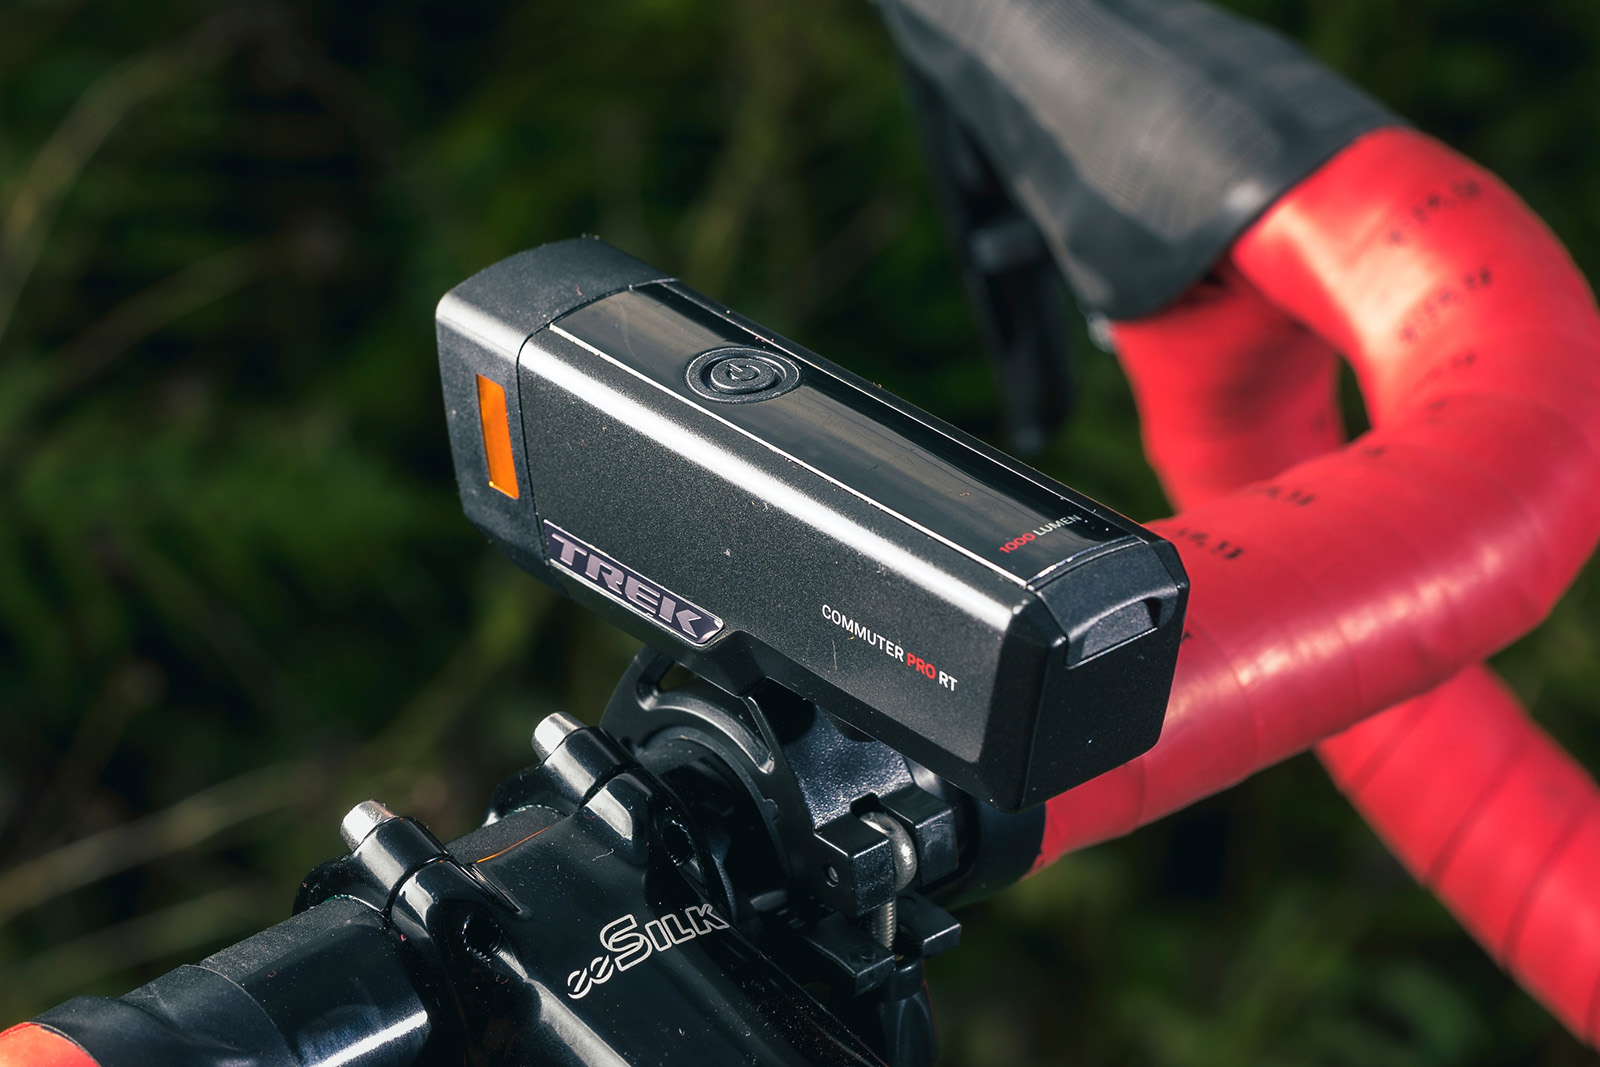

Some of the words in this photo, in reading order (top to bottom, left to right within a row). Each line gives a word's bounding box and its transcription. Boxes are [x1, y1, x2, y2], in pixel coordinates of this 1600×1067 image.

[999, 532, 1036, 554] 1000
[1032, 514, 1082, 536] LUMEN
[552, 533, 702, 638] TREK
[821, 604, 904, 663] COMMUTER
[906, 652, 937, 680] PRO
[938, 670, 958, 692] RT
